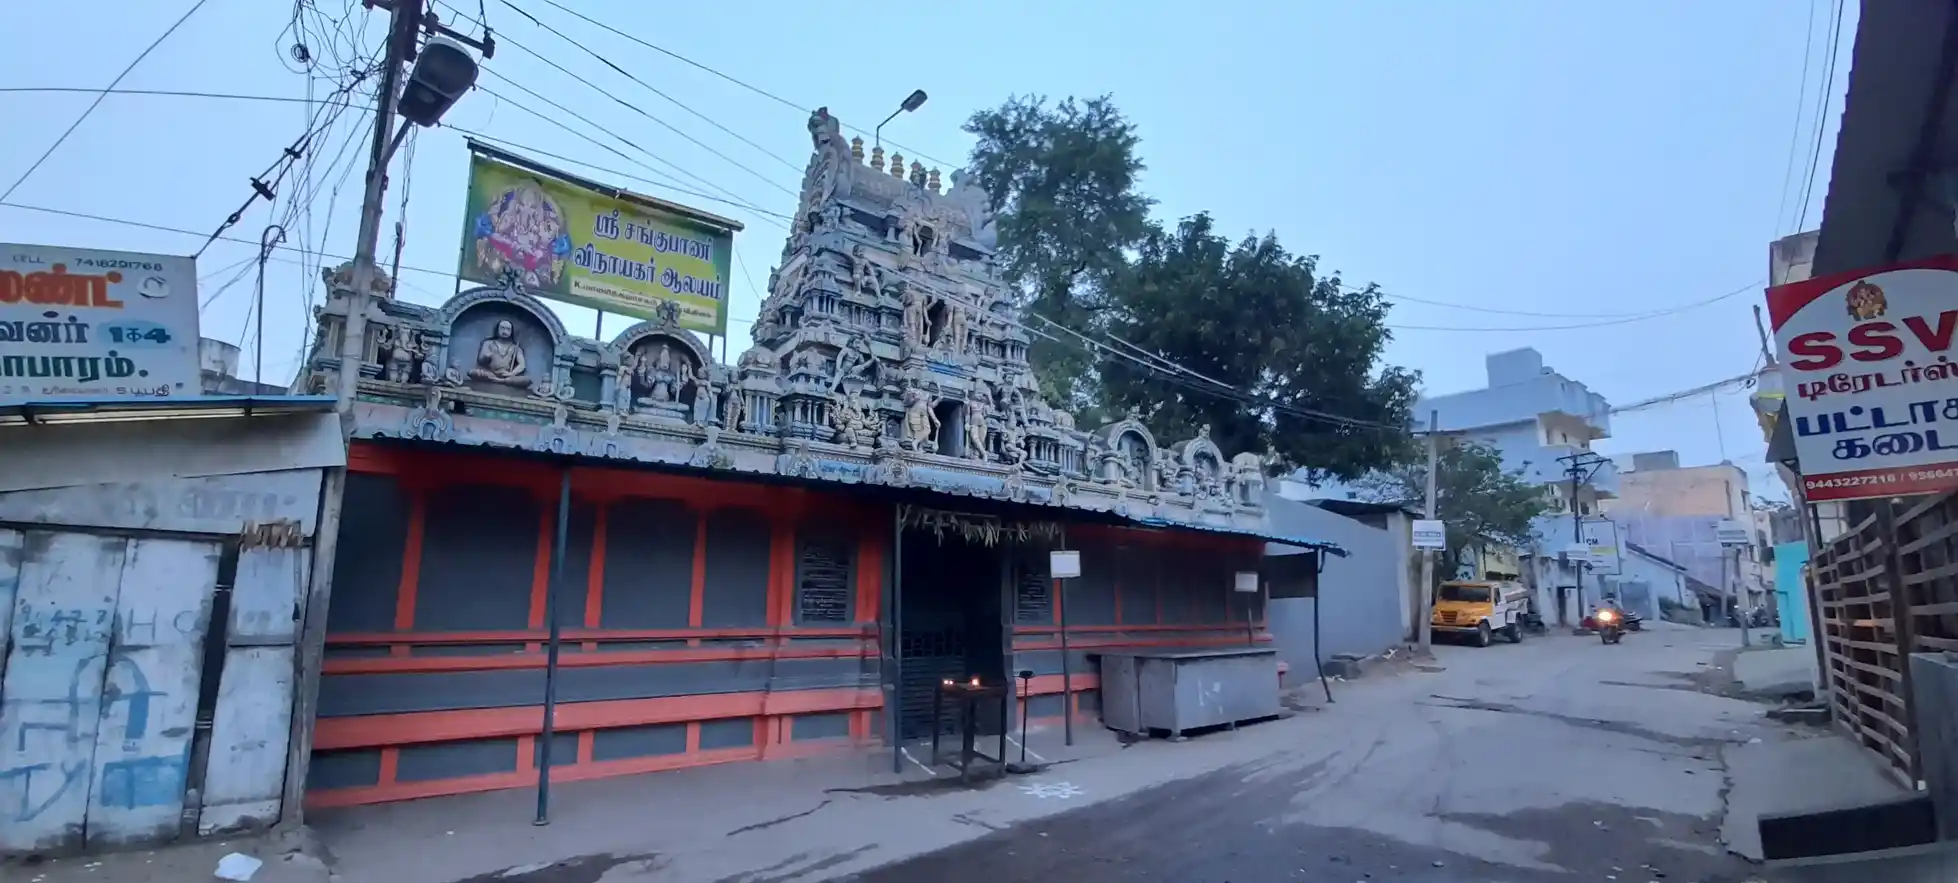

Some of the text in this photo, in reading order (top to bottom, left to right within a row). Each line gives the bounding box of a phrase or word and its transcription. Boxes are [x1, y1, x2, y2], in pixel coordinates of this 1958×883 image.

[624, 219, 714, 261] சங்குபாணி
[574, 243, 656, 284] விநாயகர்
[661, 267, 724, 300] ஆலயம்
[1789, 310, 1958, 371] SSV
